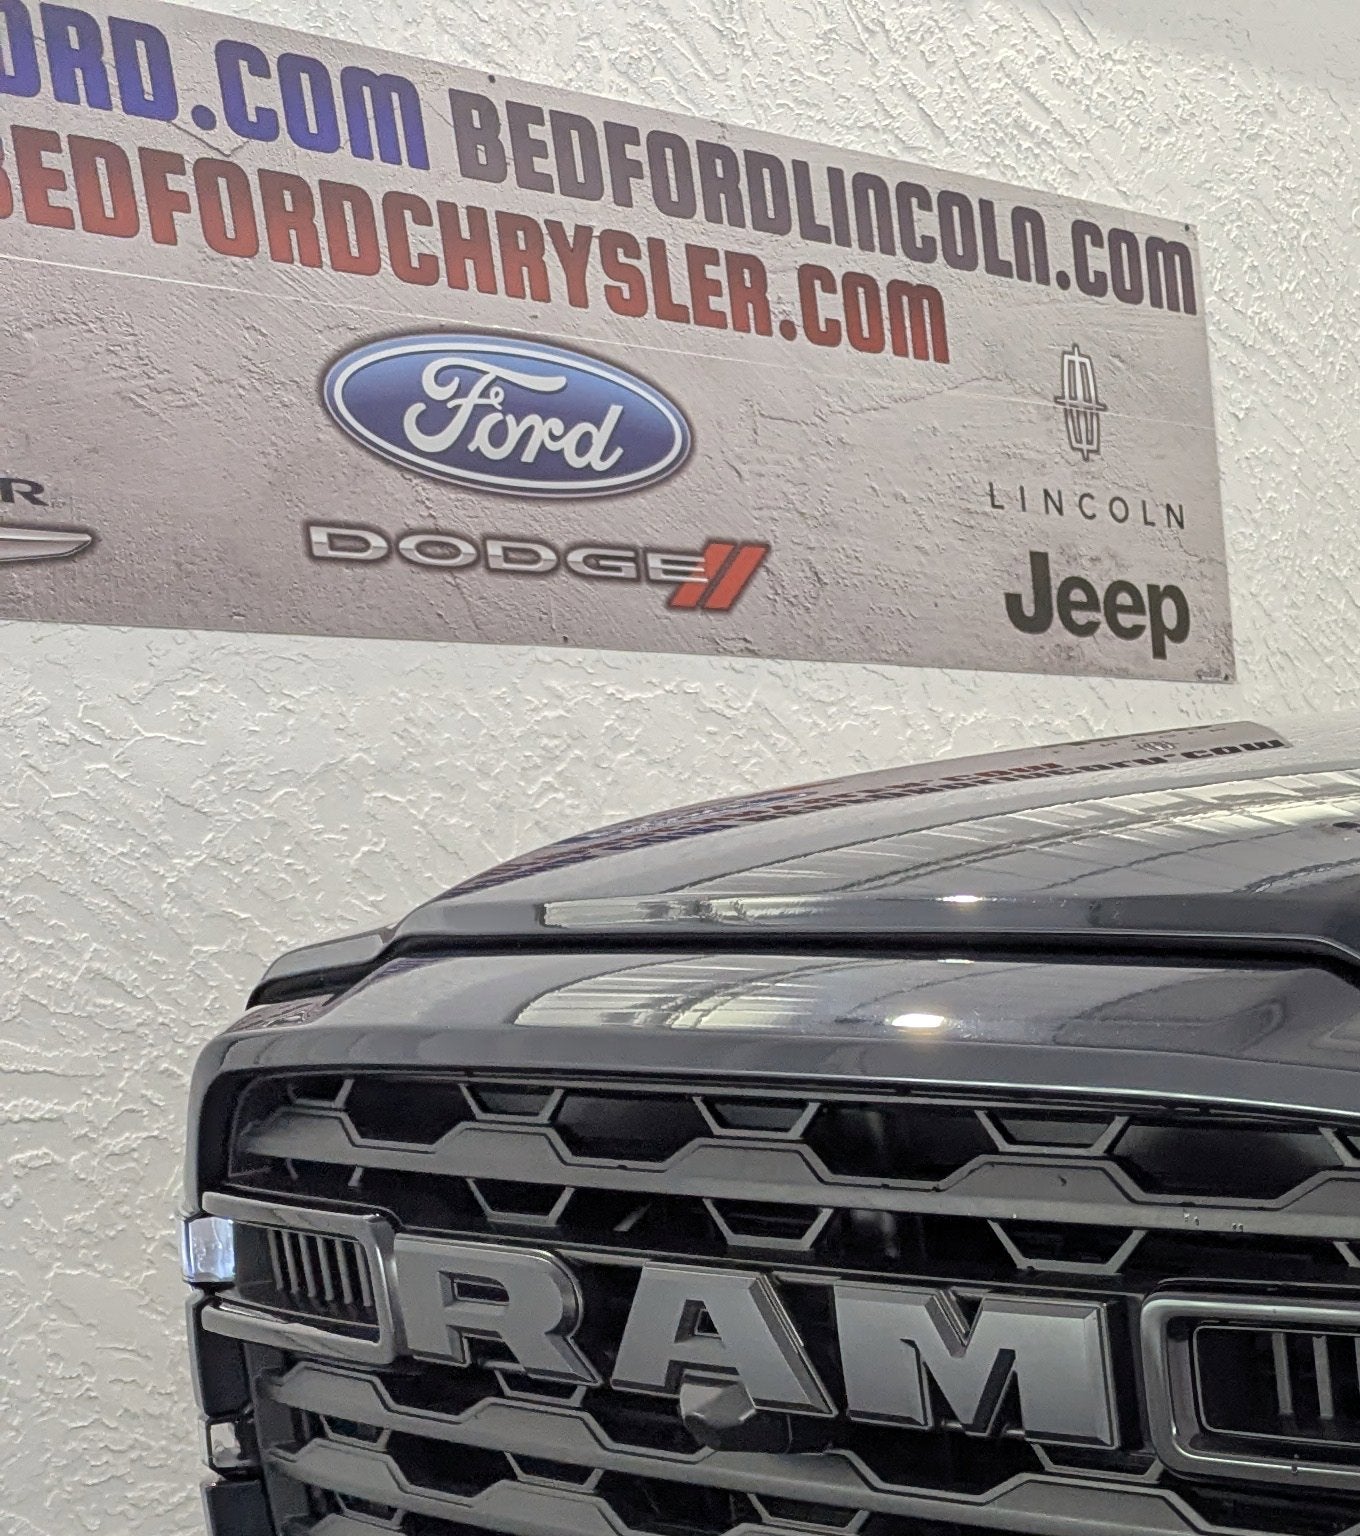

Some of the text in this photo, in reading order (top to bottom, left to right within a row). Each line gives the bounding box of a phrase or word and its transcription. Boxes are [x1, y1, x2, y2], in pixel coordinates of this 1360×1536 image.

[0, 124, 950, 365] EDFORDCHRYSLER.COM
[448, 87, 1197, 316] BEDFORDLINCOLN.COM
[403, 357, 625, 472] Ford
[306, 524, 709, 585] DODGE
[988, 481, 1185, 530] LINCOLN
[1003, 550, 1191, 660] Jeep
[393, 1231, 1119, 1450] RAM
